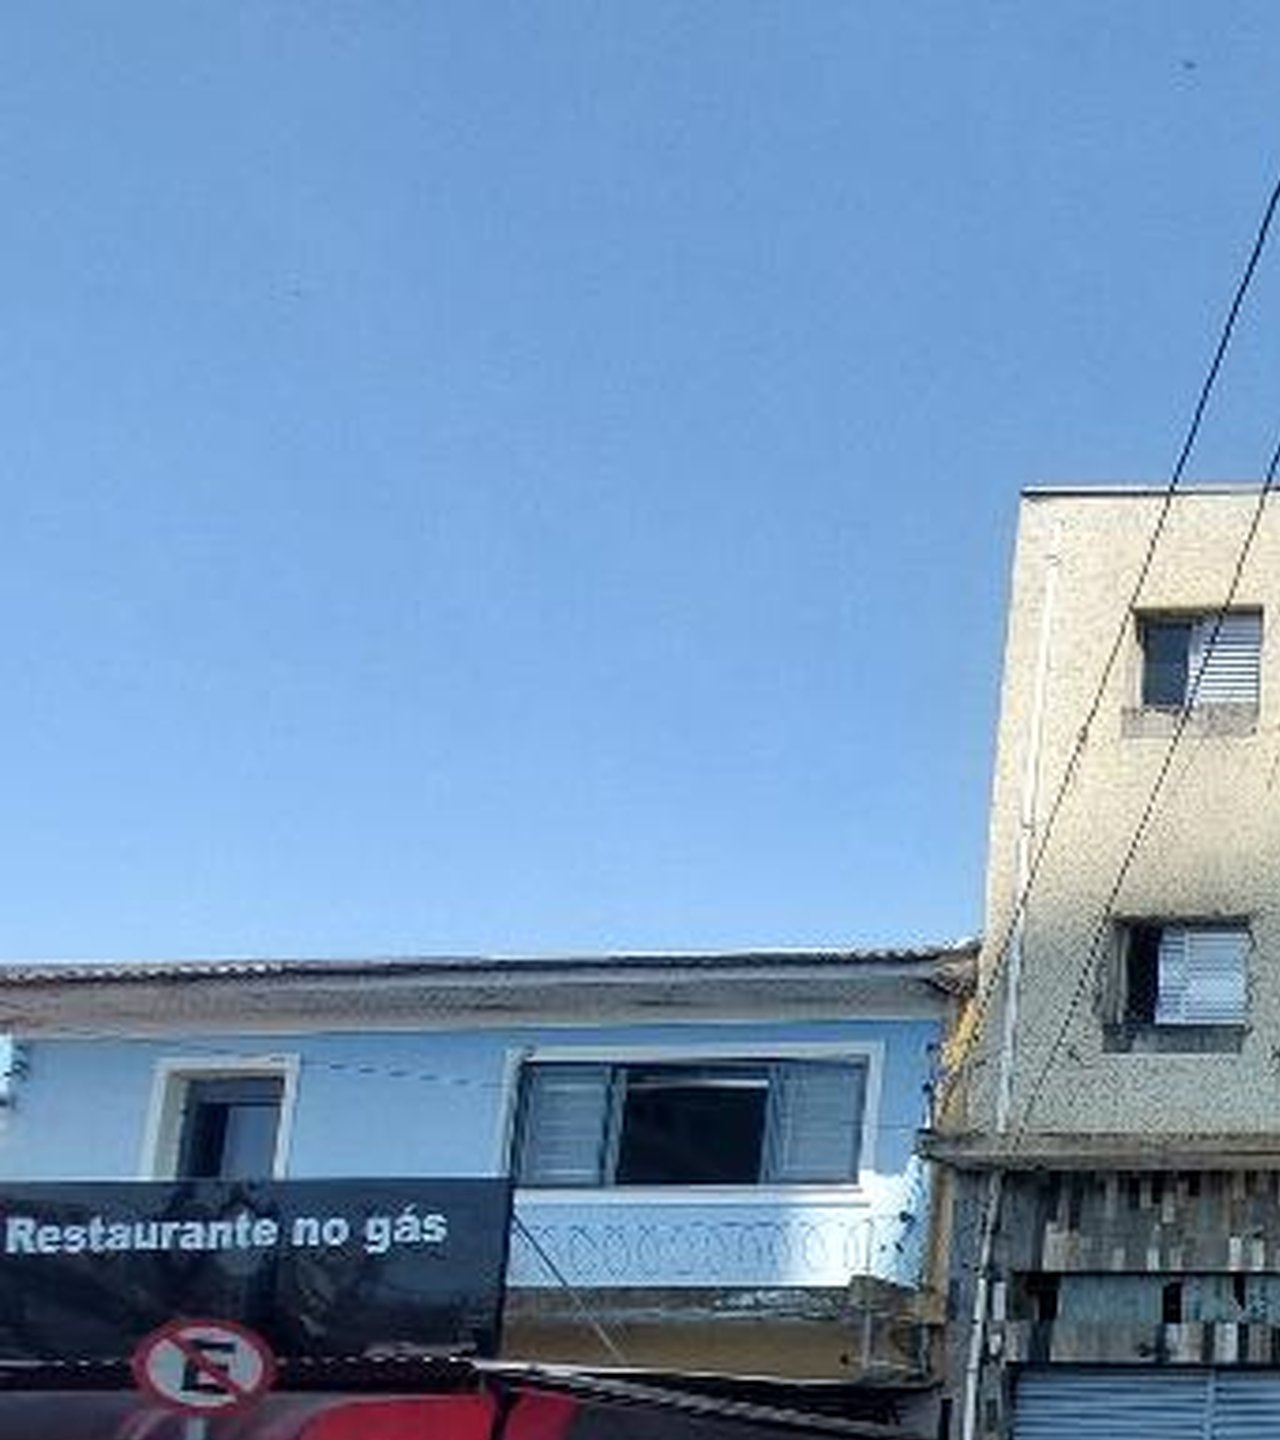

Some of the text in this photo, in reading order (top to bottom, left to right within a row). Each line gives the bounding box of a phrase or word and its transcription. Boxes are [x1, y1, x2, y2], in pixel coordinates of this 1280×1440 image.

[5, 1204, 447, 1253] Restaurante no gás
